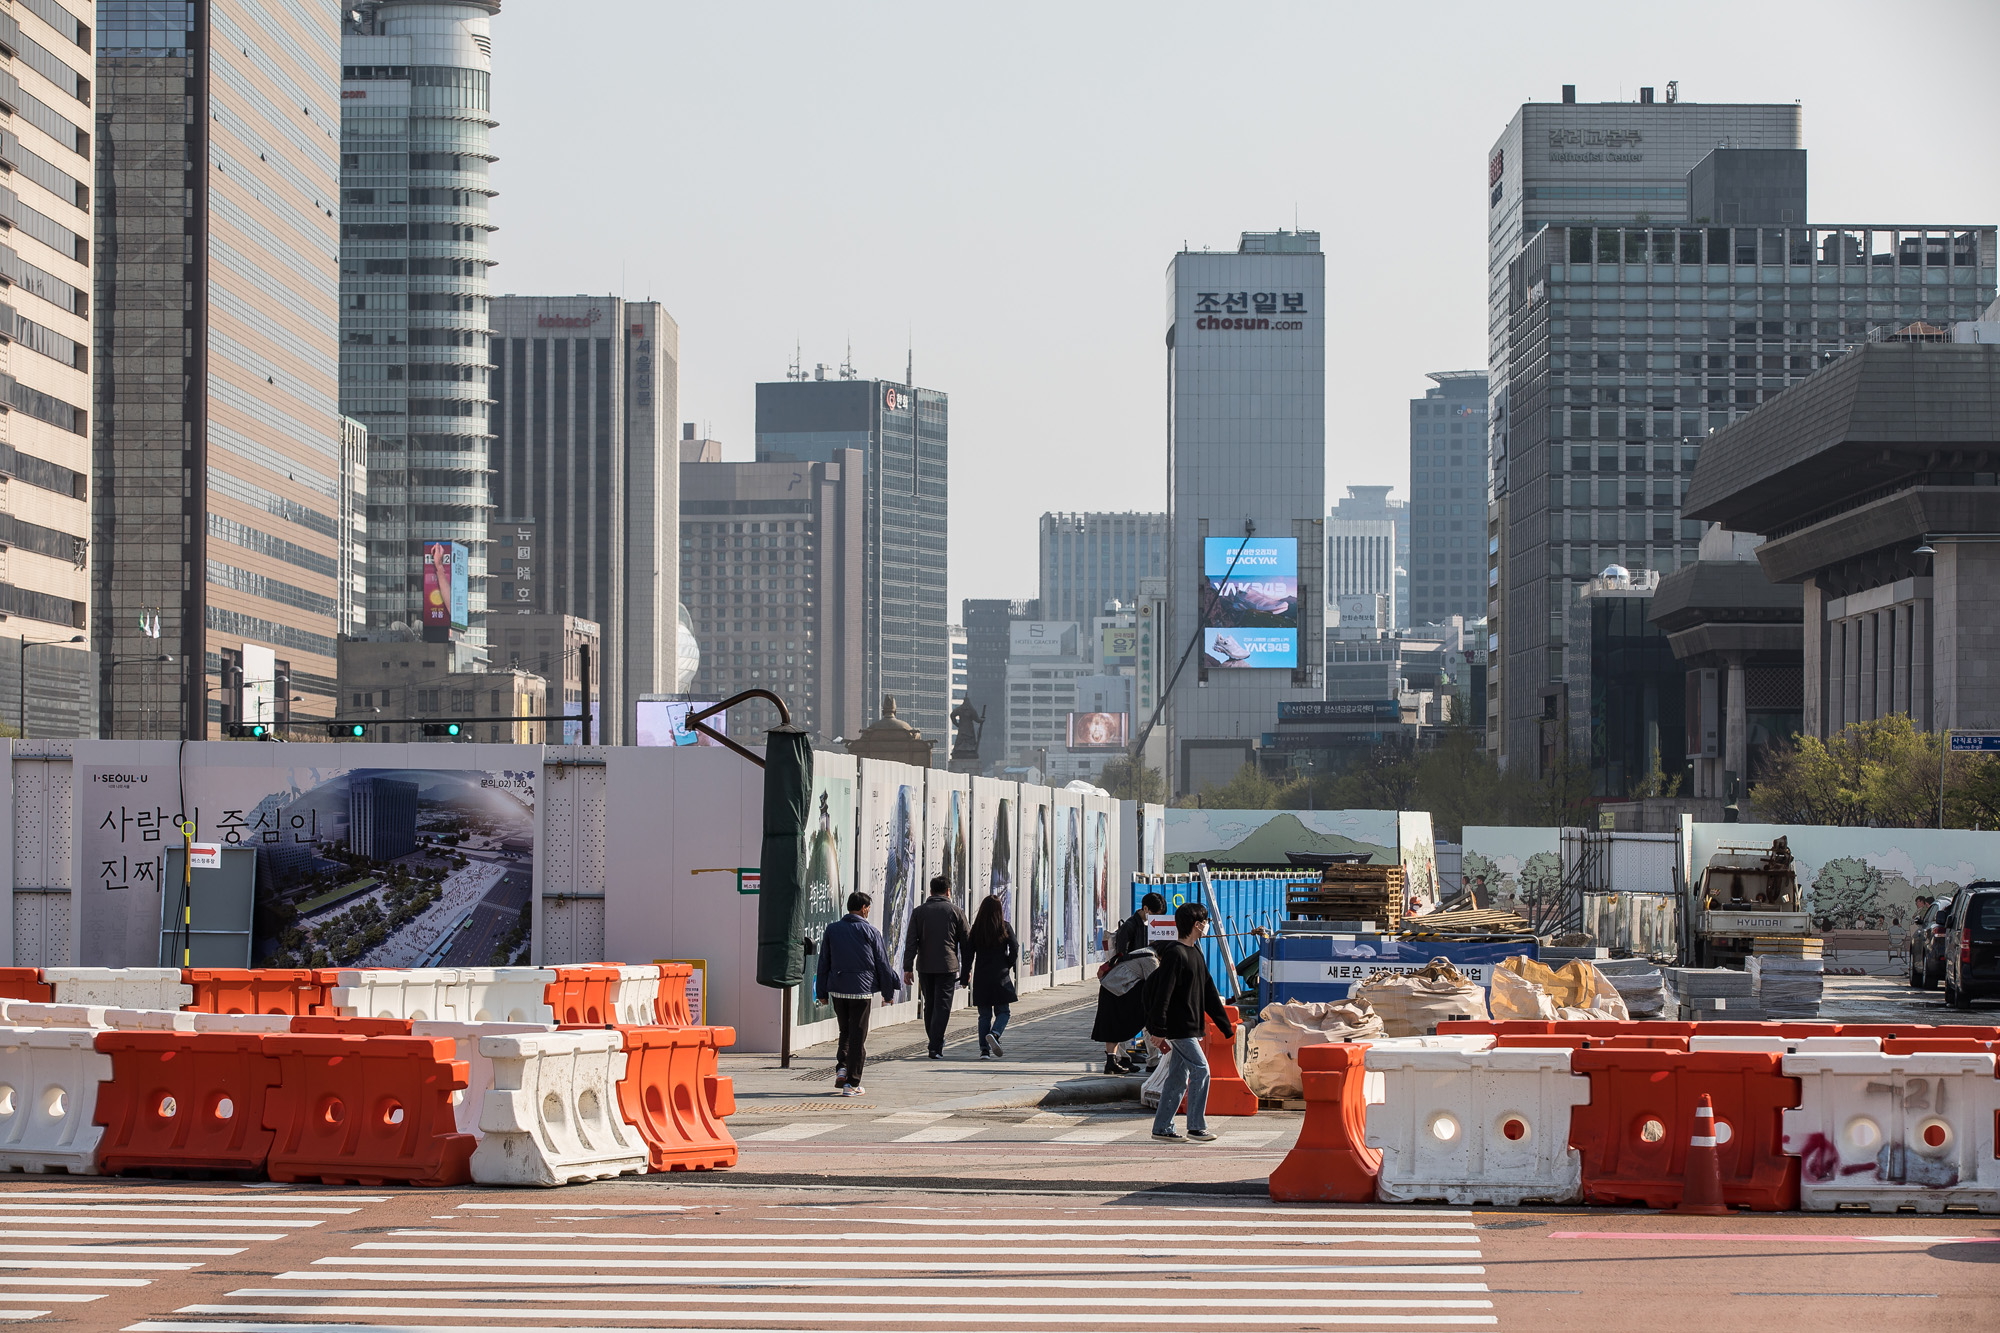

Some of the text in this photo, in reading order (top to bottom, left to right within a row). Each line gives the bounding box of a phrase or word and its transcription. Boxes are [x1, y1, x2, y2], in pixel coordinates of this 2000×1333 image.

[1549, 128, 1643, 148] 감리교본부
[1550, 151, 1643, 163] Methodist Center
[1194, 291, 1308, 314] 조선일보
[538, 313, 592, 328] kobaco
[1196, 314, 1303, 330] chosun.com
[635, 339, 651, 406] 서울신문
[1291, 705, 1321, 715] 신한은행
[513, 780, 527, 788] 120
[99, 806, 318, 844] 사람이 중심인
[100, 855, 164, 893] 진짜
[1737, 919, 1782, 927] HYUNDAI
[1327, 965, 1363, 979] 새로운
